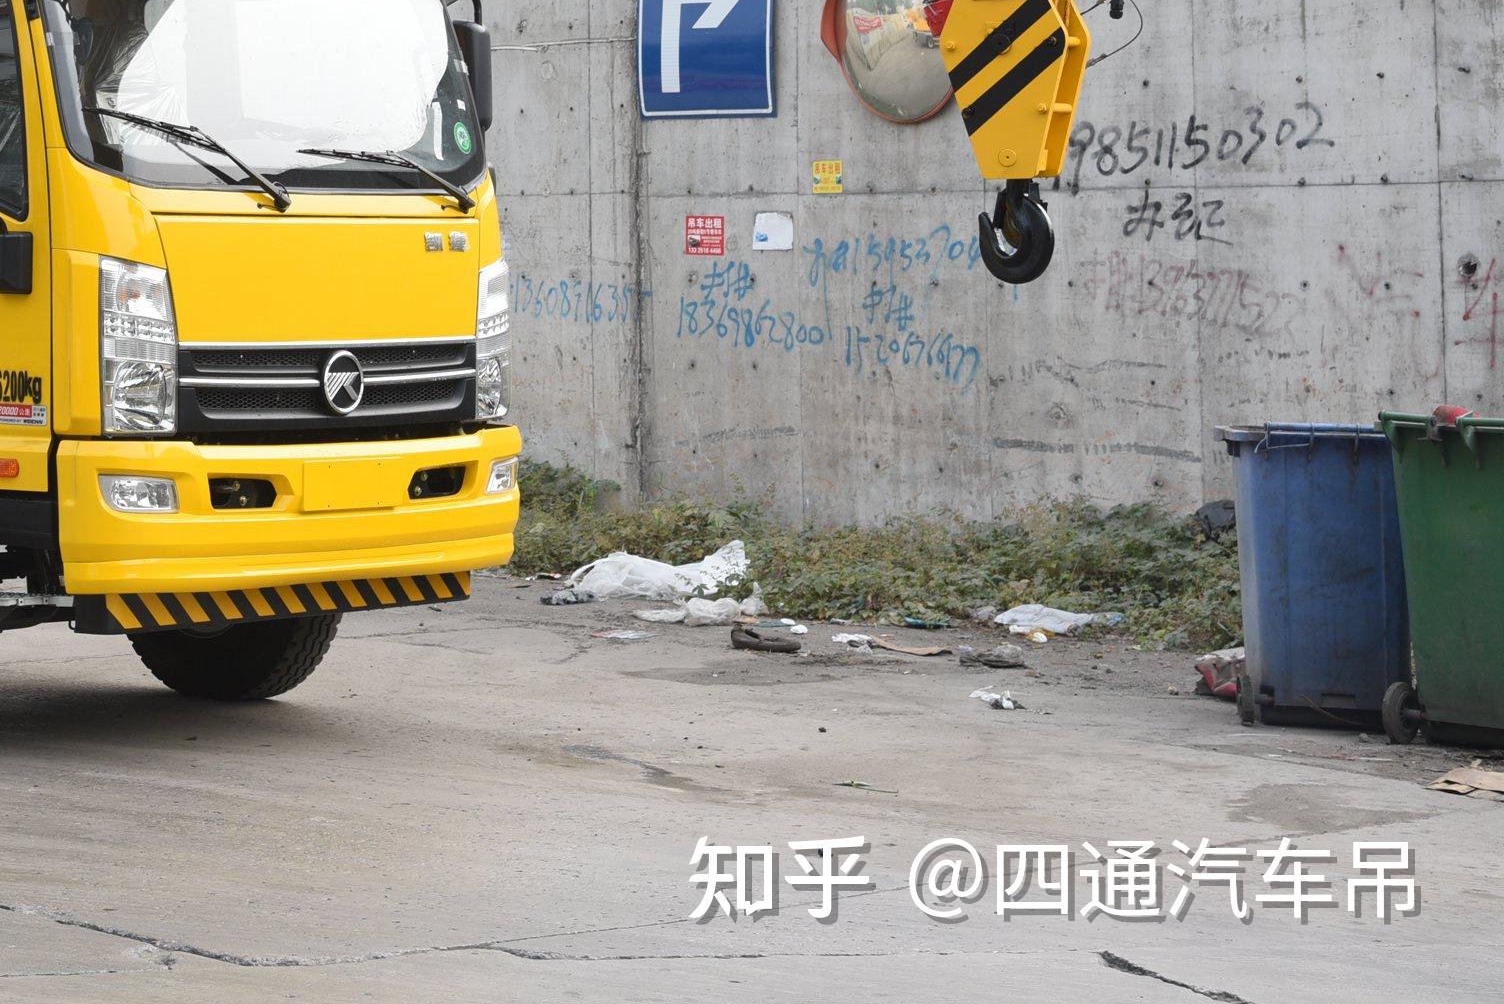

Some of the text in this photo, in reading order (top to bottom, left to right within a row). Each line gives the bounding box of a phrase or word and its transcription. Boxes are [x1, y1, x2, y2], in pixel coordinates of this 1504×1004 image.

[1053, 102, 1335, 195] 9851150302
[688, 218, 722, 228] 吊车出租
